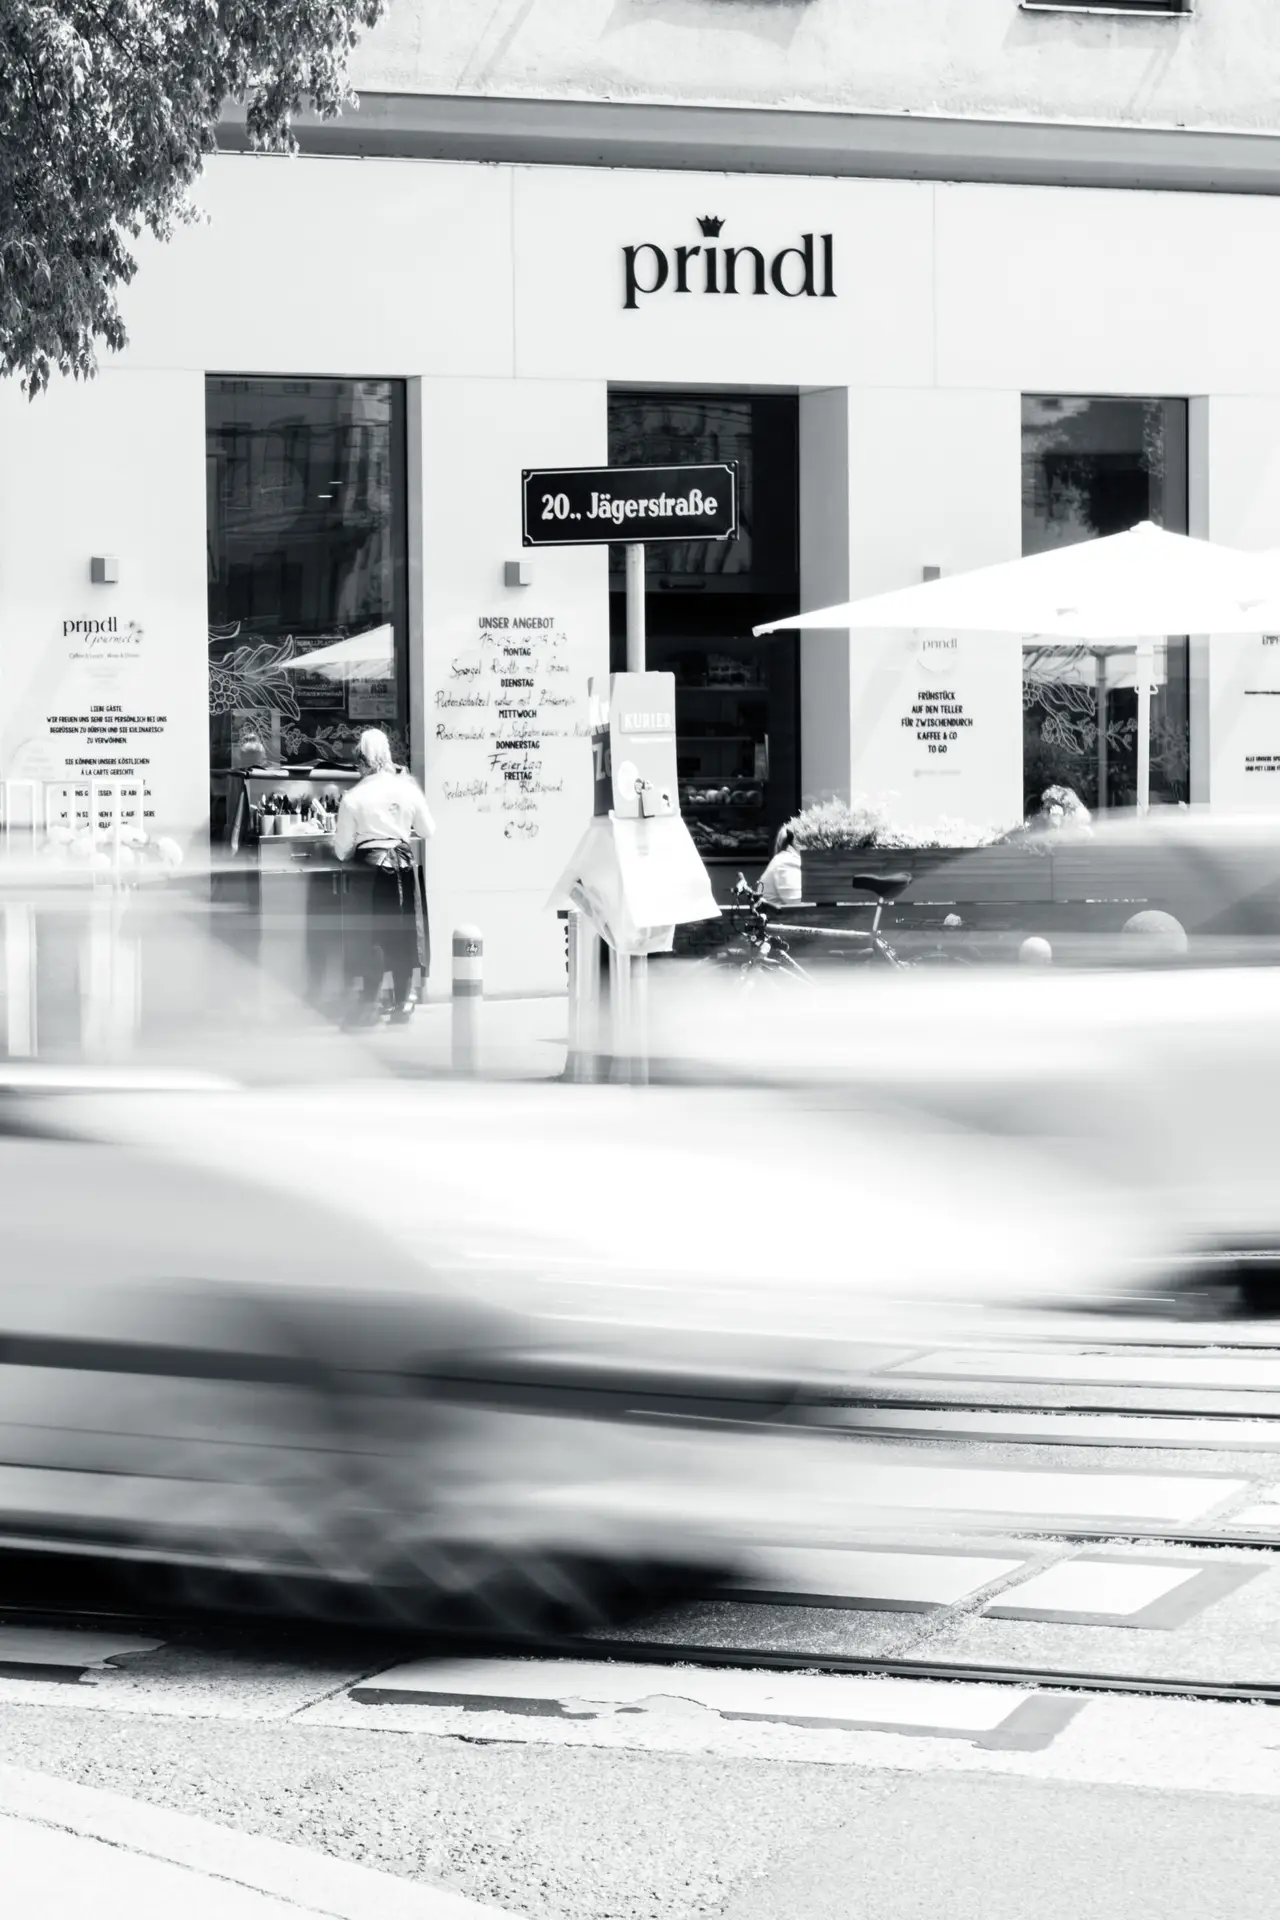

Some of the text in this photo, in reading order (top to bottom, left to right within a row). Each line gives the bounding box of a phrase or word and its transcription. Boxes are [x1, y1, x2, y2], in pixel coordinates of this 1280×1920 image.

[621, 233, 838, 310] prindl
[541, 488, 718, 525] 20., Jägerstraße
[62, 616, 118, 637] prindl
[478, 617, 554, 629] UNSER ANGEBOT
[503, 647, 531, 656] MONTAG
[500, 679, 534, 688] DIENSTAG
[918, 690, 956, 701] FRÜHSTÜCK
[90, 705, 104, 713] LIEBE
[911, 705, 963, 714] AUF DEN TELLER
[114, 714, 146, 723] PERSÖNLICH
[498, 710, 537, 719] MITTWOCH
[624, 712, 673, 729] KURIER
[901, 716, 973, 728] FÜR ZWISCHENDURCH
[87, 725, 107, 733] DÜRFEN
[917, 732, 941, 741] KAFFEE
[949, 732, 957, 740] CO
[496, 741, 540, 750] DONNERSTAG
[928, 745, 948, 753] TO GO
[75, 757, 97, 765] KÖNNEN
[118, 757, 151, 765] KÖSTLICHEN
[504, 772, 532, 781] FREITAG
